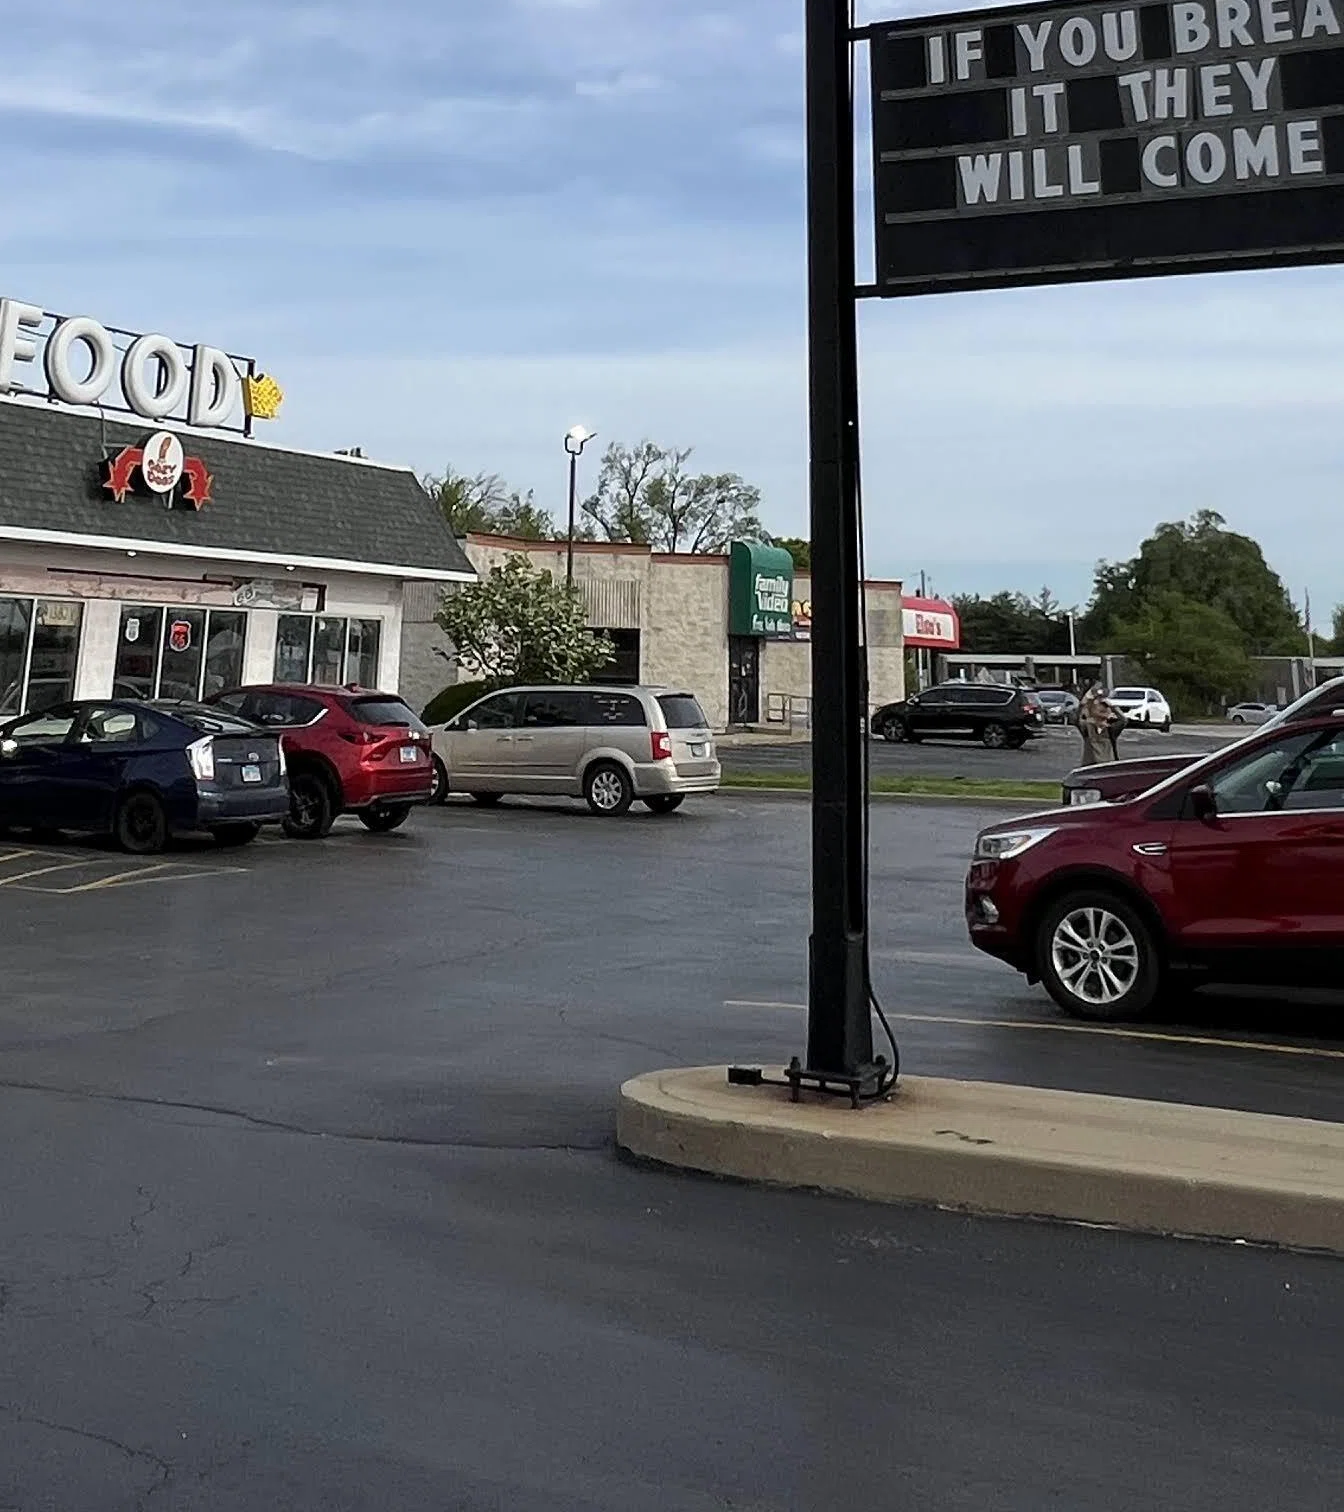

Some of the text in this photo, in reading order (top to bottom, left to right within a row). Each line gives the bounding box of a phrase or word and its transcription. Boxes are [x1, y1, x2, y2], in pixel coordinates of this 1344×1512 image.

[928, 29, 984, 84] IF
[1015, 9, 1140, 72] YOU
[1010, 56, 1277, 137] IT THEY
[957, 120, 1325, 205] WILL COME
